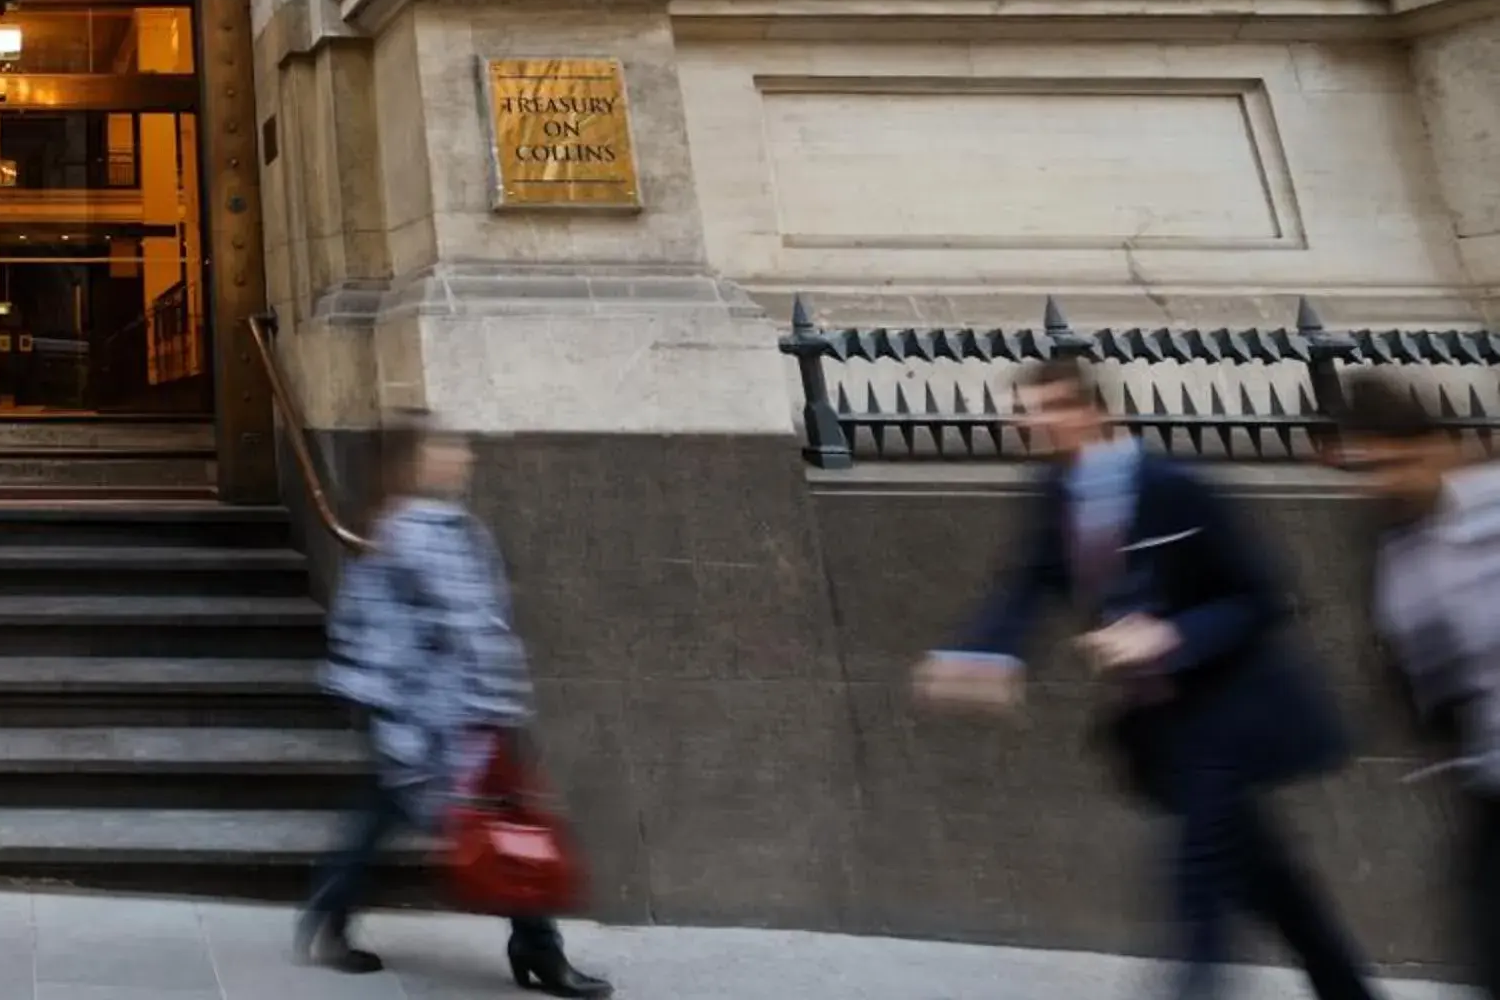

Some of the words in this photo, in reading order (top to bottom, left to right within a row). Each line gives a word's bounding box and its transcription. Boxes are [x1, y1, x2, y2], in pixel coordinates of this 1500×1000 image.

[503, 97, 616, 114] TREASURY
[543, 120, 580, 137] ON
[515, 144, 616, 162] COLLINS
